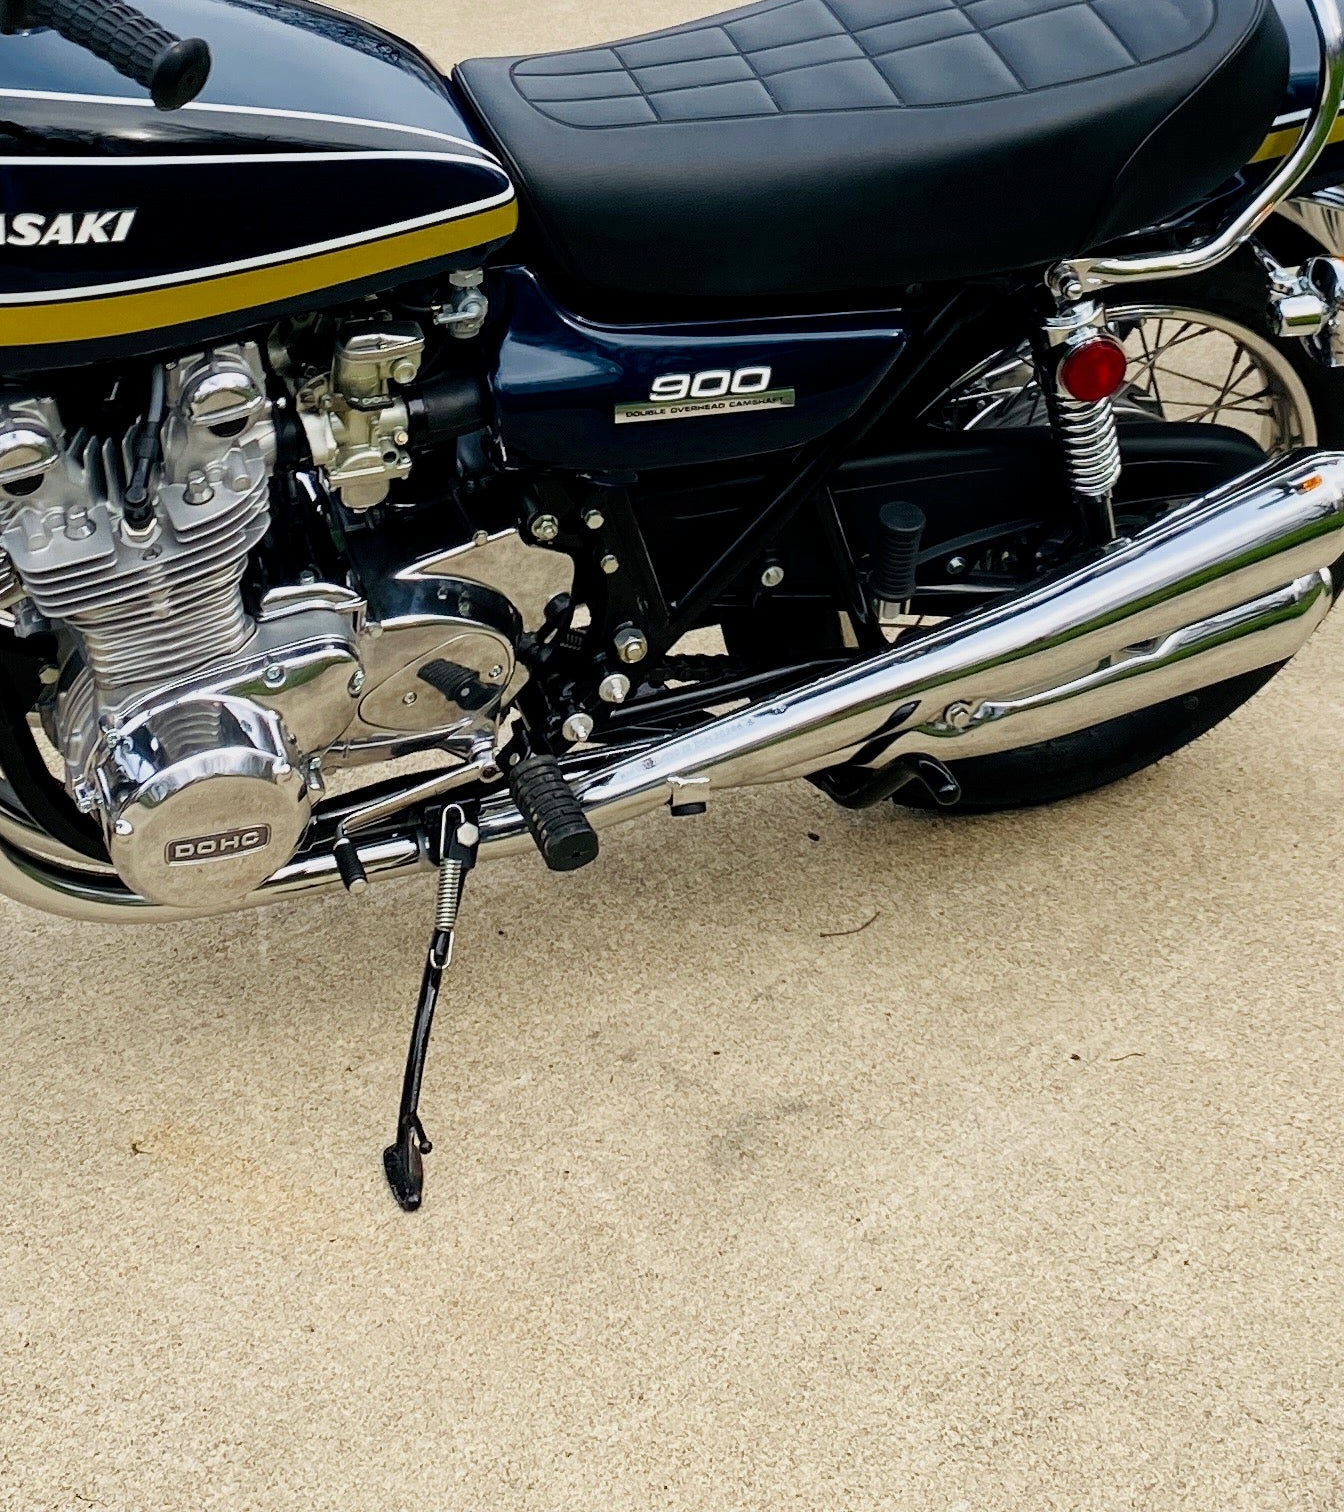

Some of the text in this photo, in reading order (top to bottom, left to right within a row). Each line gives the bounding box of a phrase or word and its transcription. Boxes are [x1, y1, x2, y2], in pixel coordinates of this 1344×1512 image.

[649, 366, 772, 401] 900
[626, 396, 784, 418] DOUBLE OVERHEAD CAMSHAFT
[175, 831, 260, 858] DOHC
